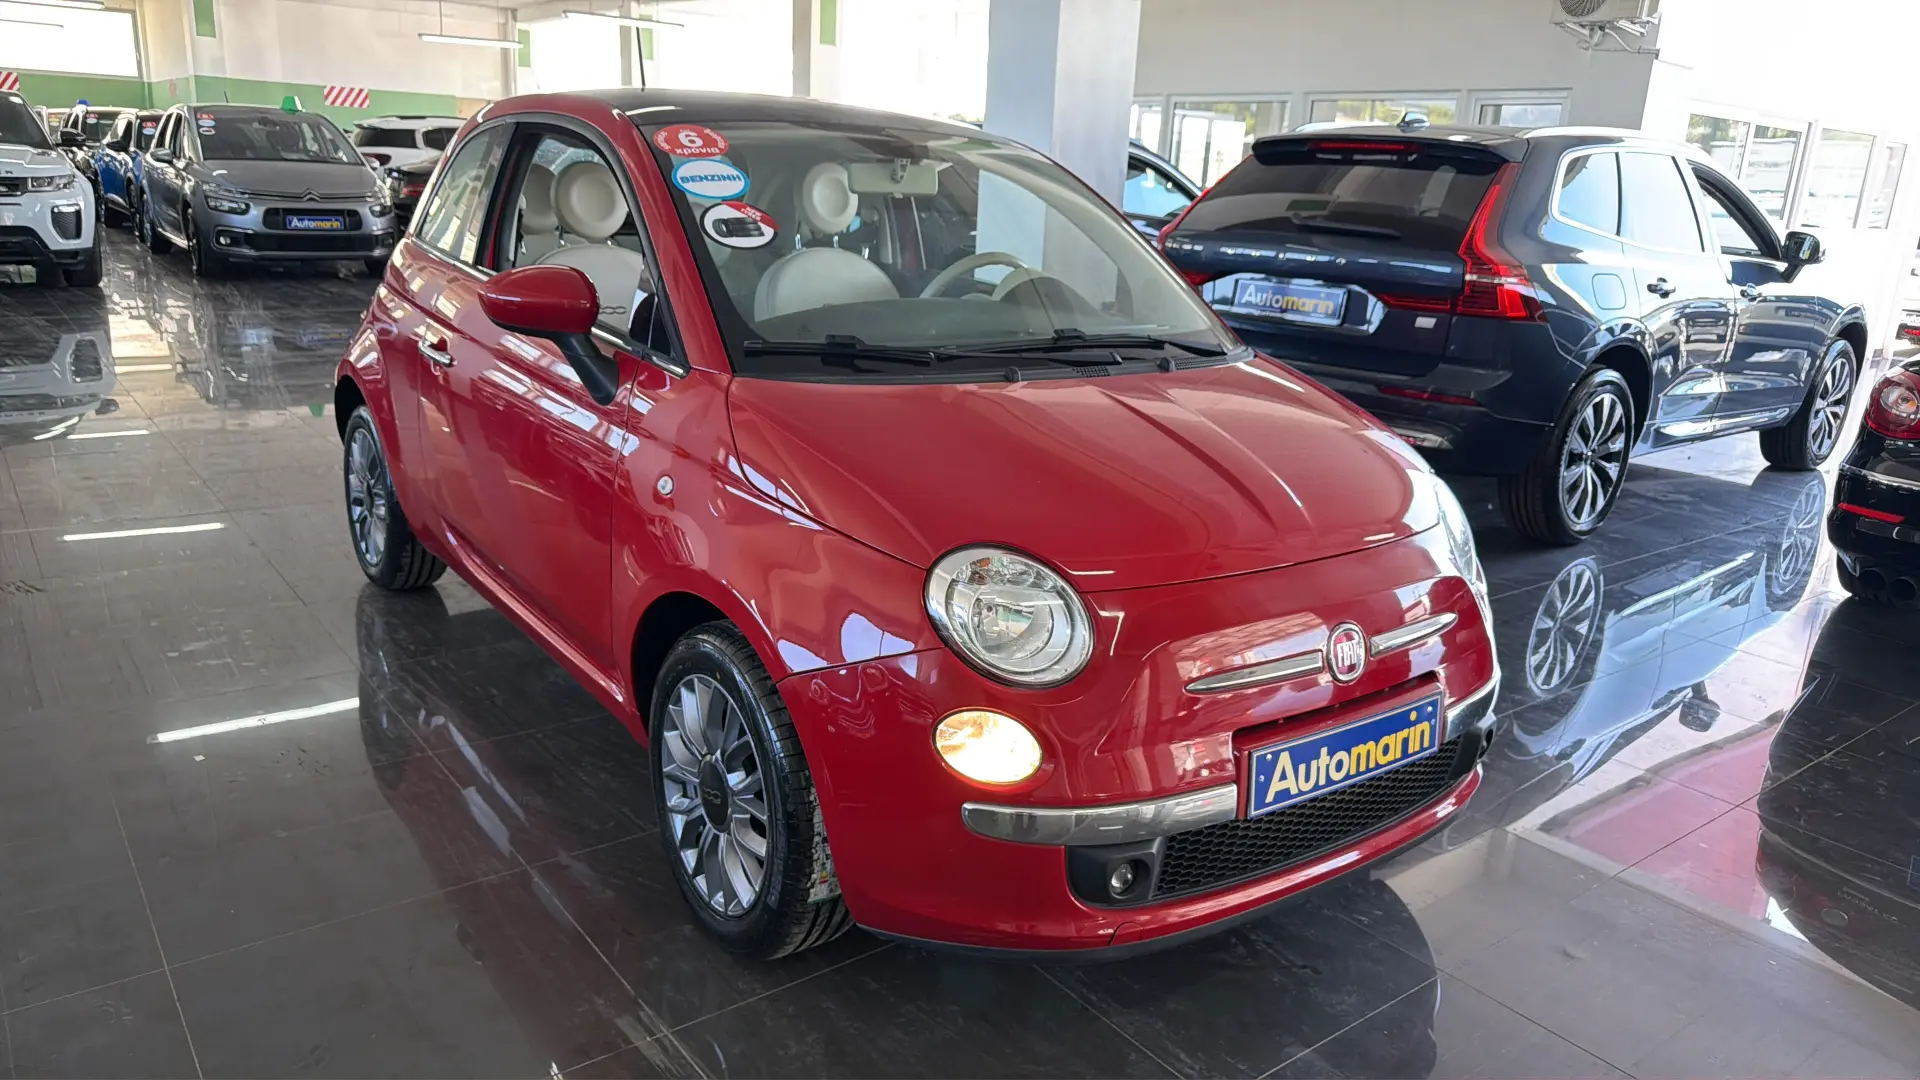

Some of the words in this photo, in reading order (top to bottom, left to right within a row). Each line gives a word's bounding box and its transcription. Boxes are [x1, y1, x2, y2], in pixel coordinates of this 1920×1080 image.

[678, 130, 703, 148] 6
[292, 217, 341, 228] Automarin
[1241, 284, 1334, 314] Automarin
[1336, 637, 1358, 668] FIAT
[1265, 711, 1430, 803] Automarin
